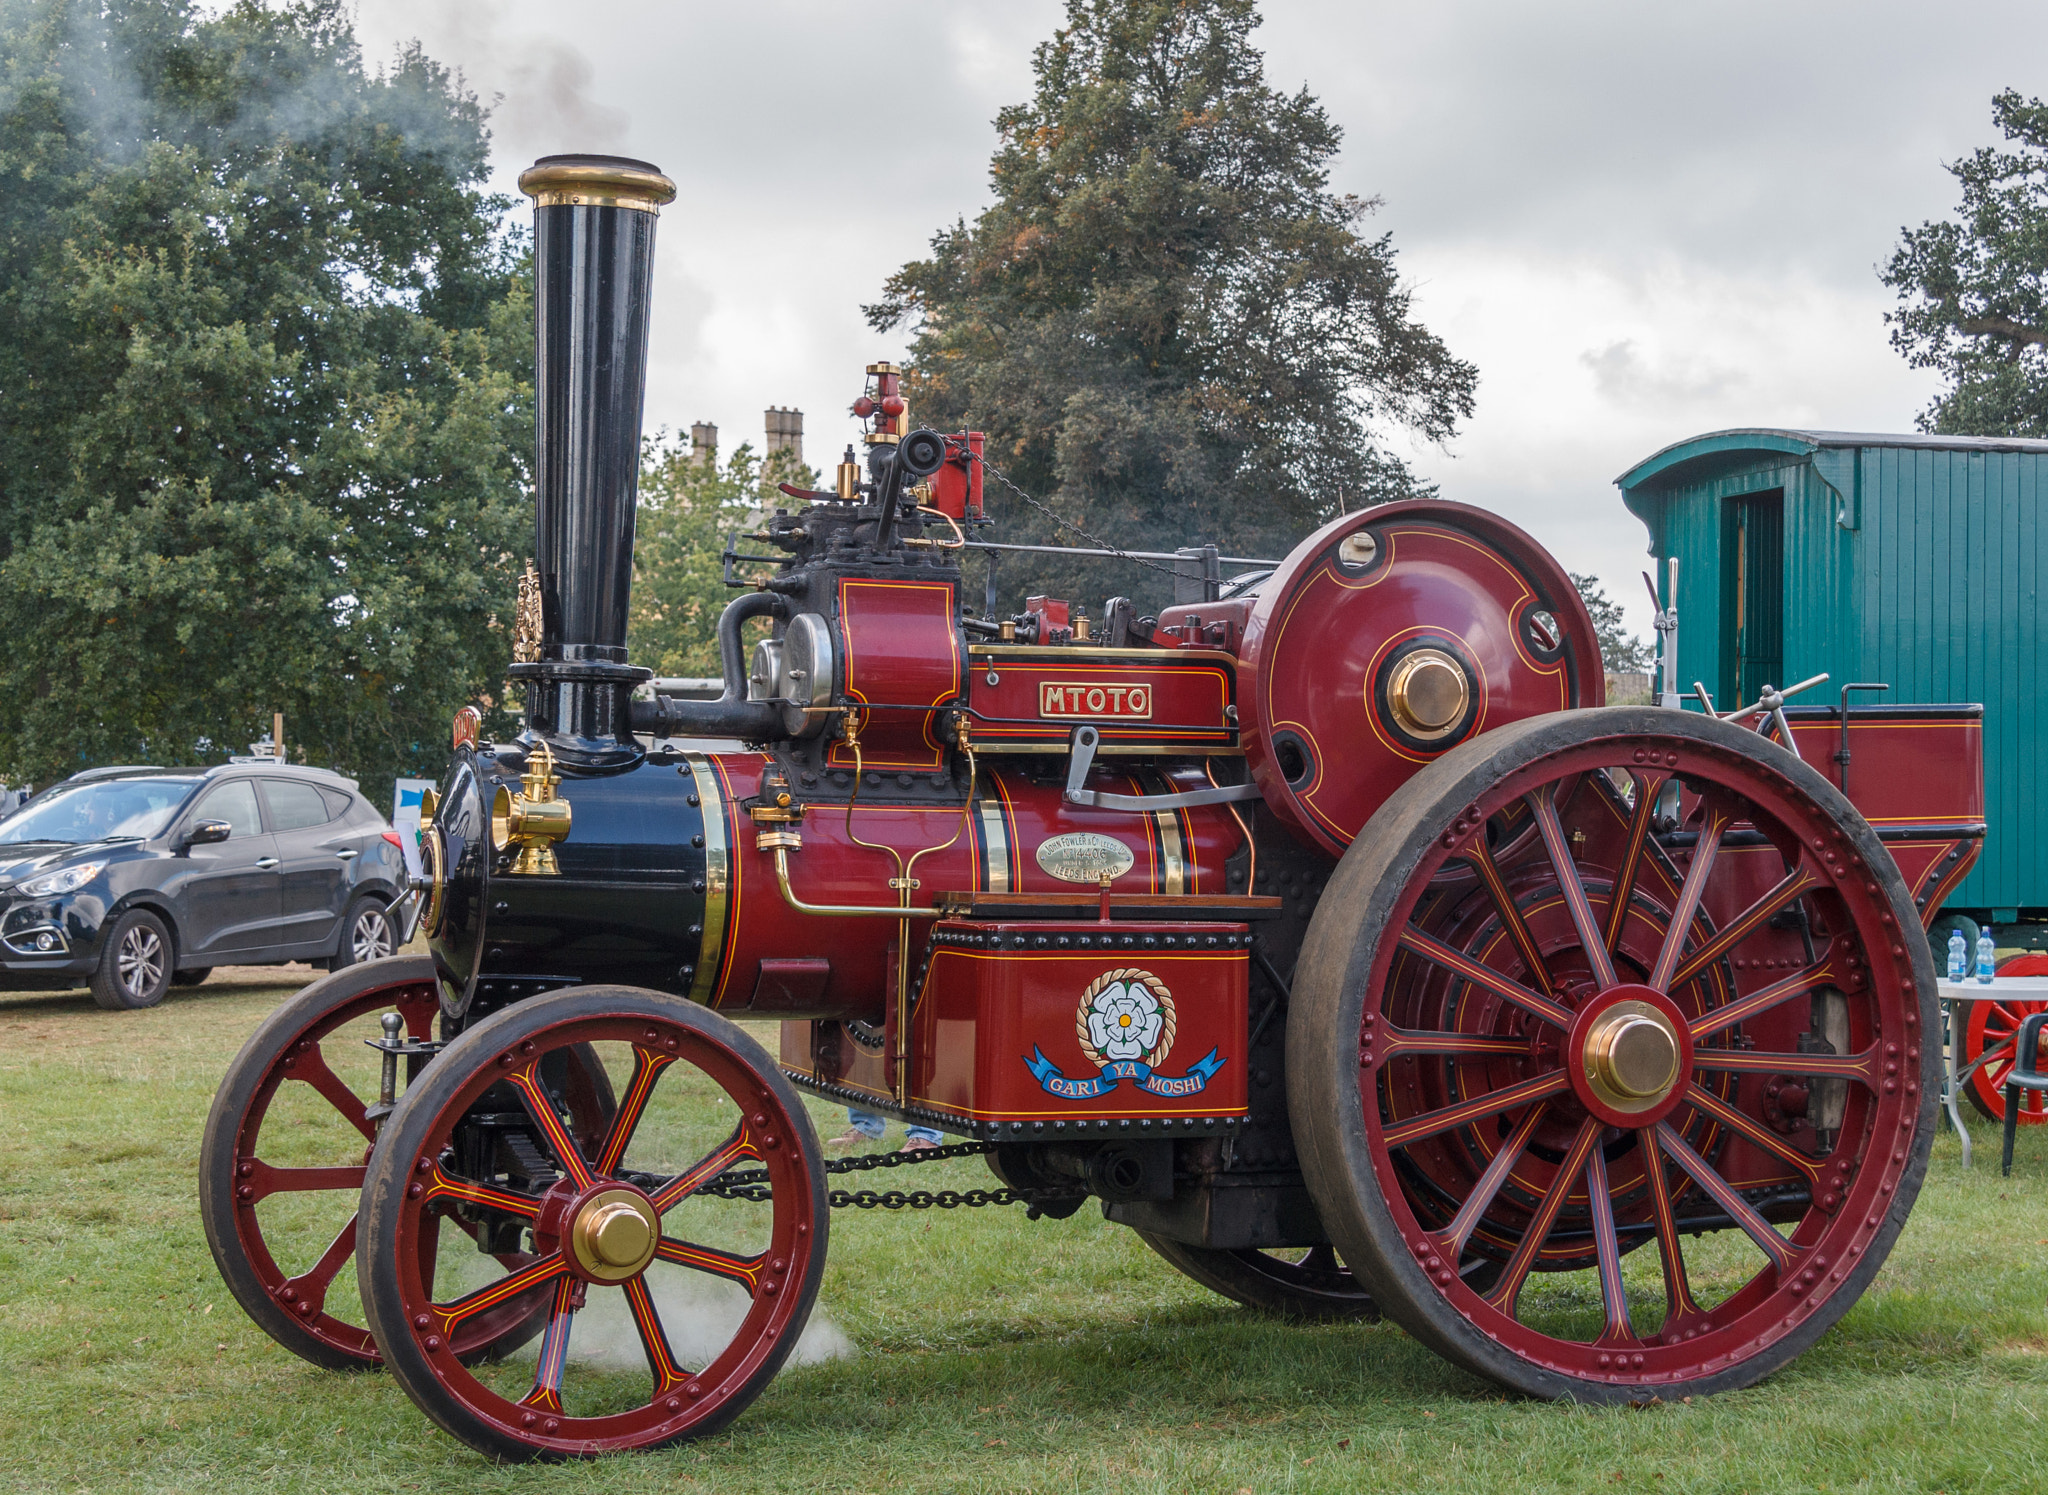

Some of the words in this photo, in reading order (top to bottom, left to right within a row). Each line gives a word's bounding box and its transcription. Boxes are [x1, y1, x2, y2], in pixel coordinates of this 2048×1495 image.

[1045, 687, 1147, 713] MTOTO
[1045, 841, 1062, 855] JOHN
[1061, 836, 1086, 847] FOWLER
[1049, 1078, 1100, 1097] GARI
[1112, 1062, 1138, 1078] YA
[1146, 1075, 1202, 1095] MOSHI
